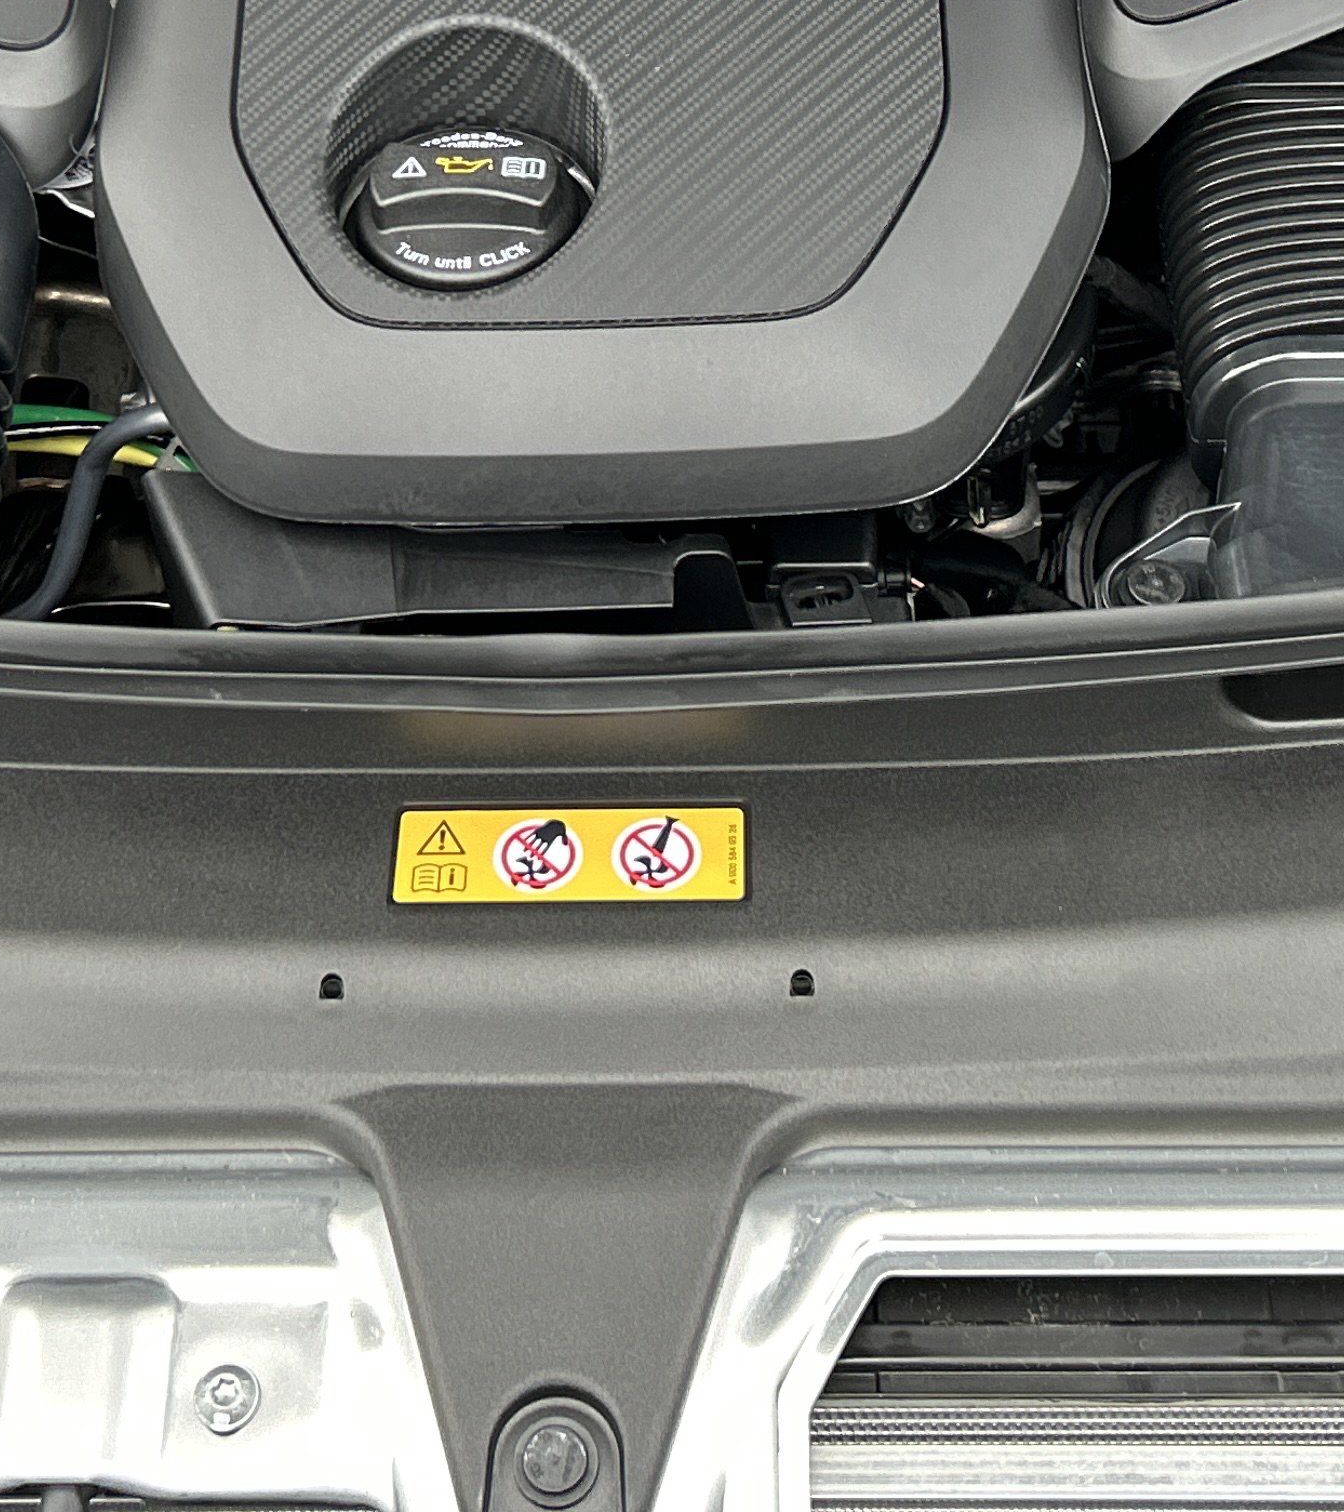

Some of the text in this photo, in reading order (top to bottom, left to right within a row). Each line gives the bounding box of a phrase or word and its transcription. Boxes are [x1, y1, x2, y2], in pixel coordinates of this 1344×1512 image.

[394, 241, 532, 270] Turn until CLICK
